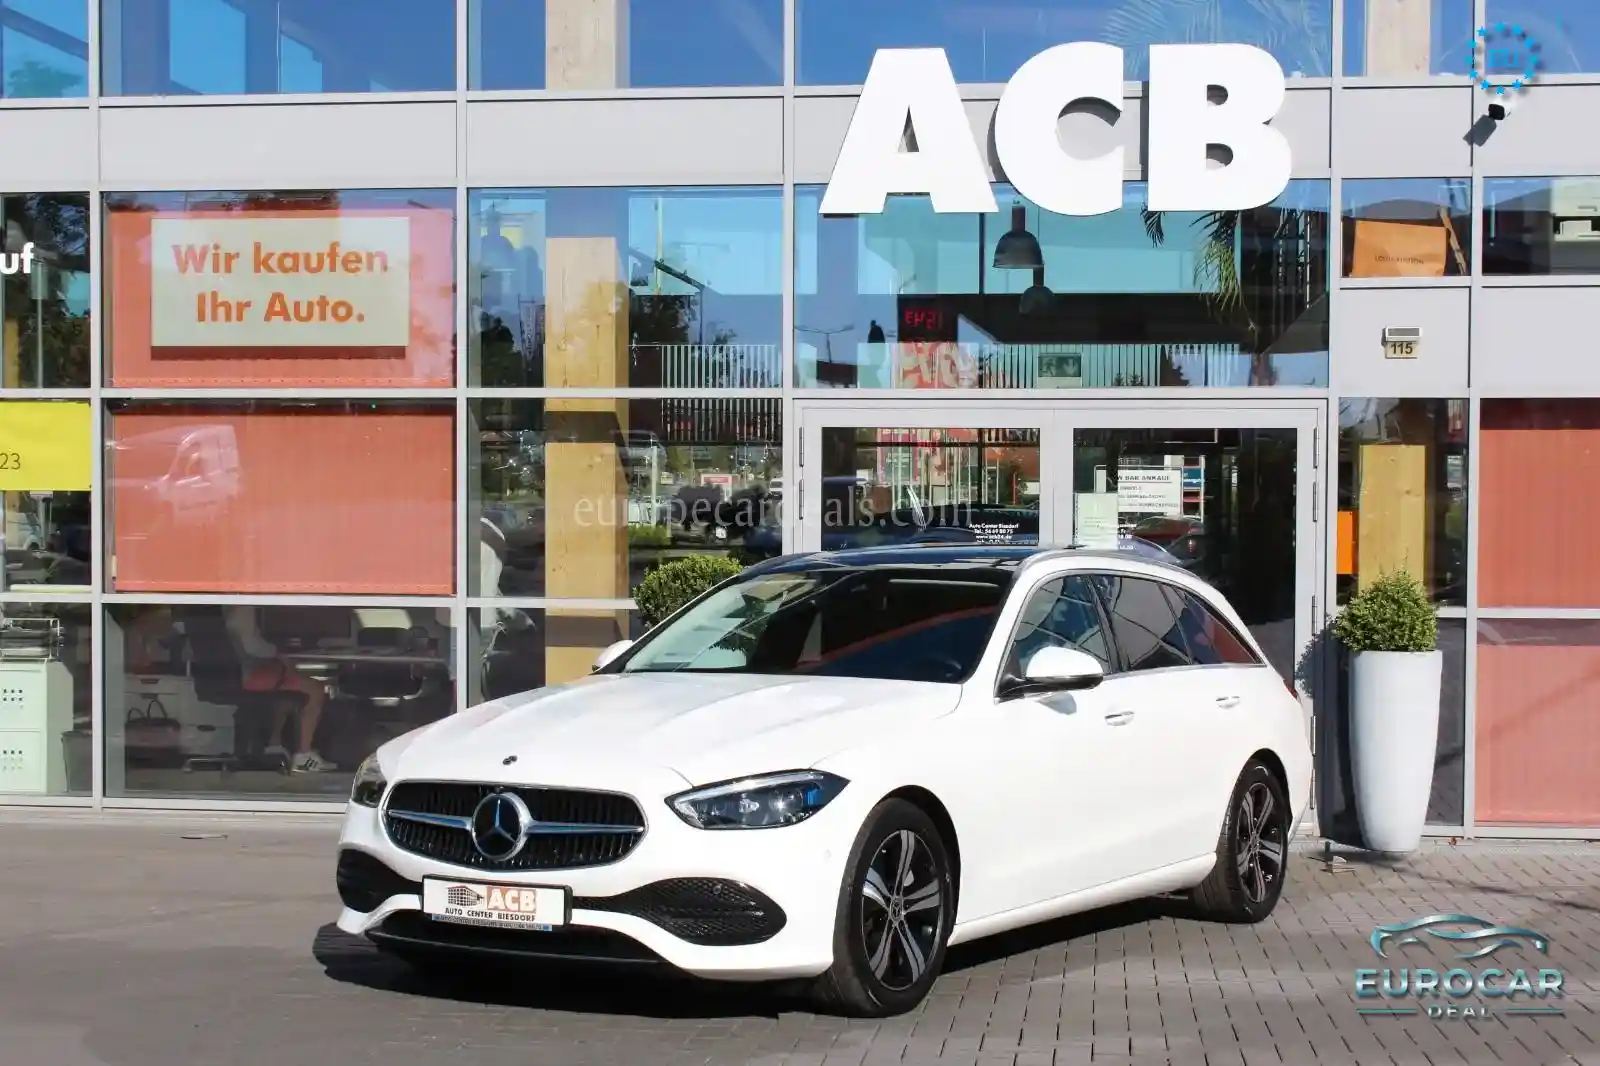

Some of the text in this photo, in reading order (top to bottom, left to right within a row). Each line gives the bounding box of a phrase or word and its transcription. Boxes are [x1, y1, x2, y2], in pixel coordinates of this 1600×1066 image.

[819, 41, 1292, 216] ACB
[0, 241, 35, 275] uf
[172, 240, 389, 274] Wir kaufen
[197, 291, 365, 322] Ihr Auto.
[1390, 342, 1413, 355] 115
[0, 452, 21, 470] 23
[488, 888, 536, 912] ACB
[445, 907, 537, 922] AUTO CENTER BIESDORF
